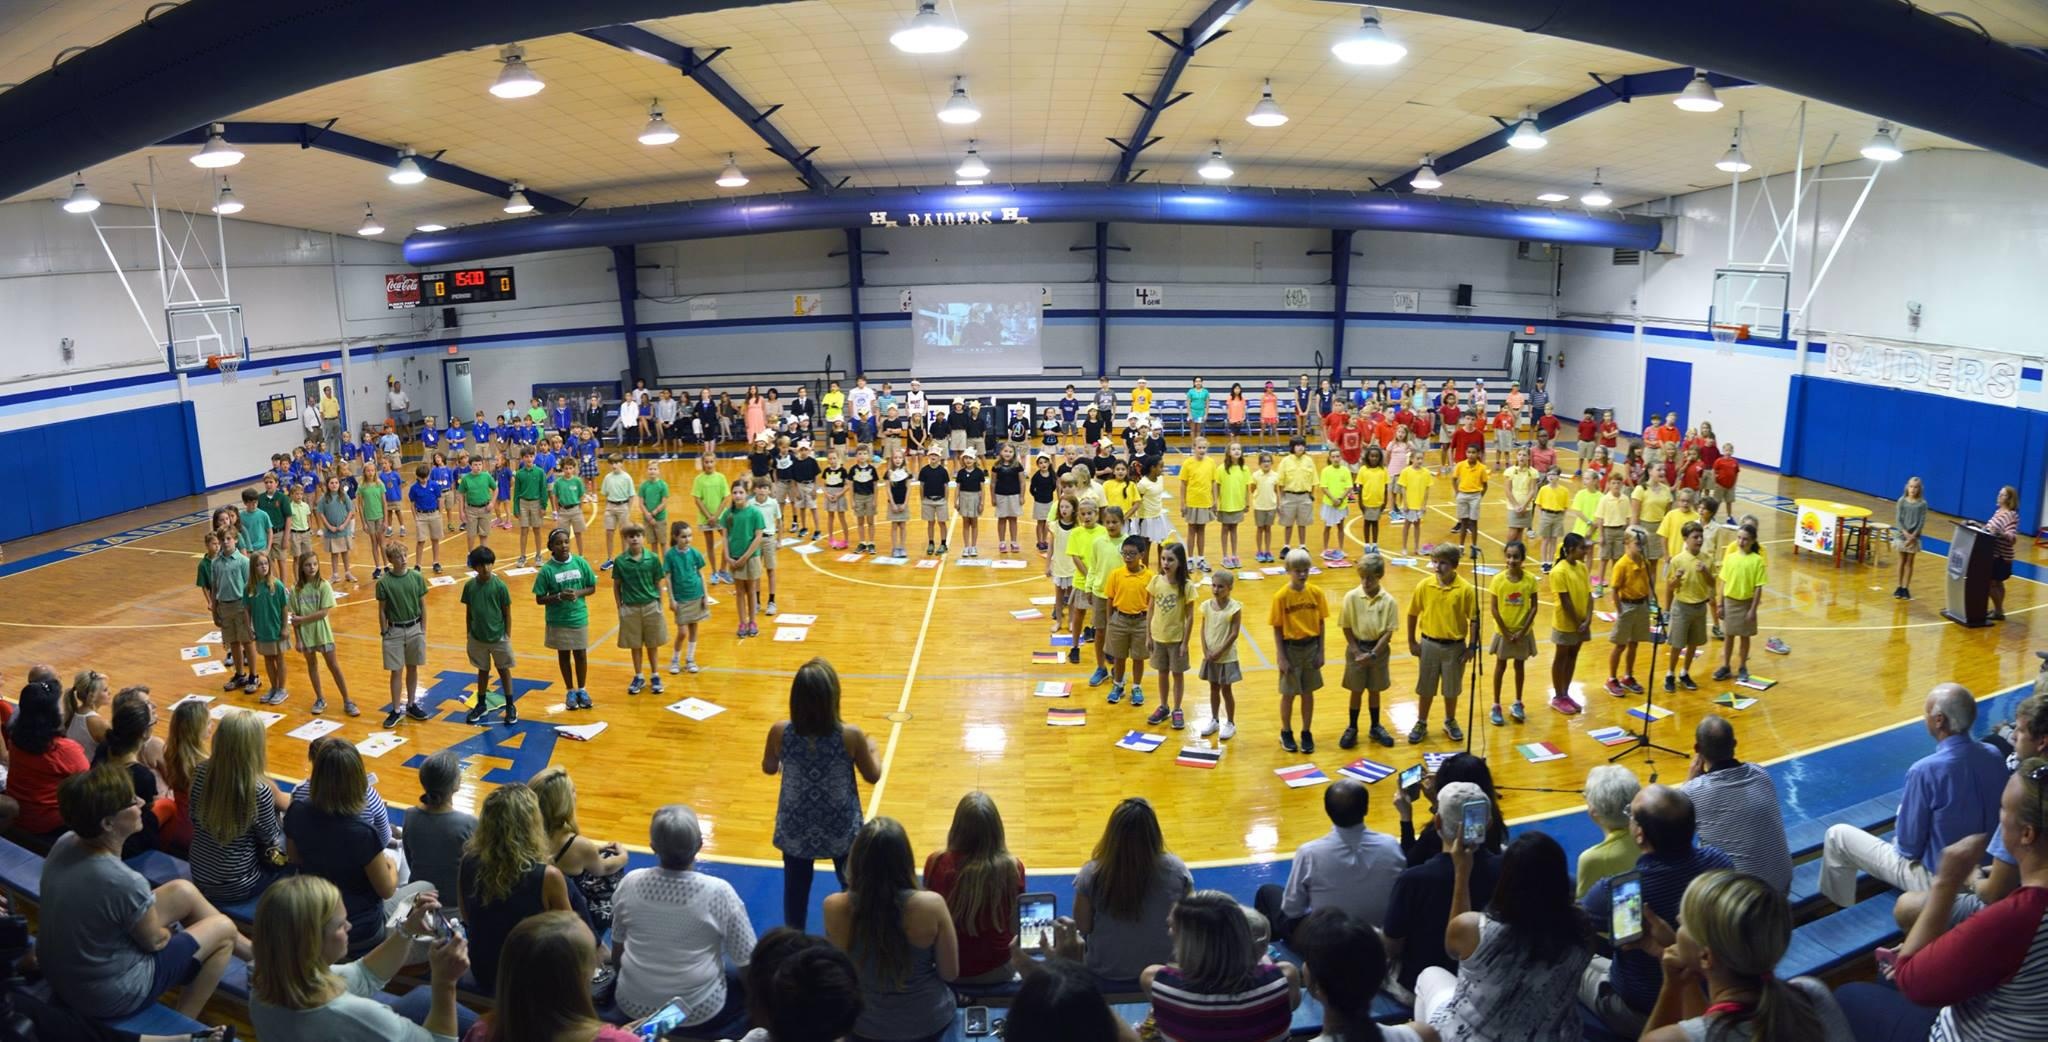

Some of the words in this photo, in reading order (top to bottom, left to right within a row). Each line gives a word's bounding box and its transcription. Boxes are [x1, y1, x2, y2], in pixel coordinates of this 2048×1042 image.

[908, 210, 993, 226] RAIDERS
[435, 282, 445, 296] 0
[501, 277, 510, 291] 0
[1827, 342, 2016, 399] RAIDERS
